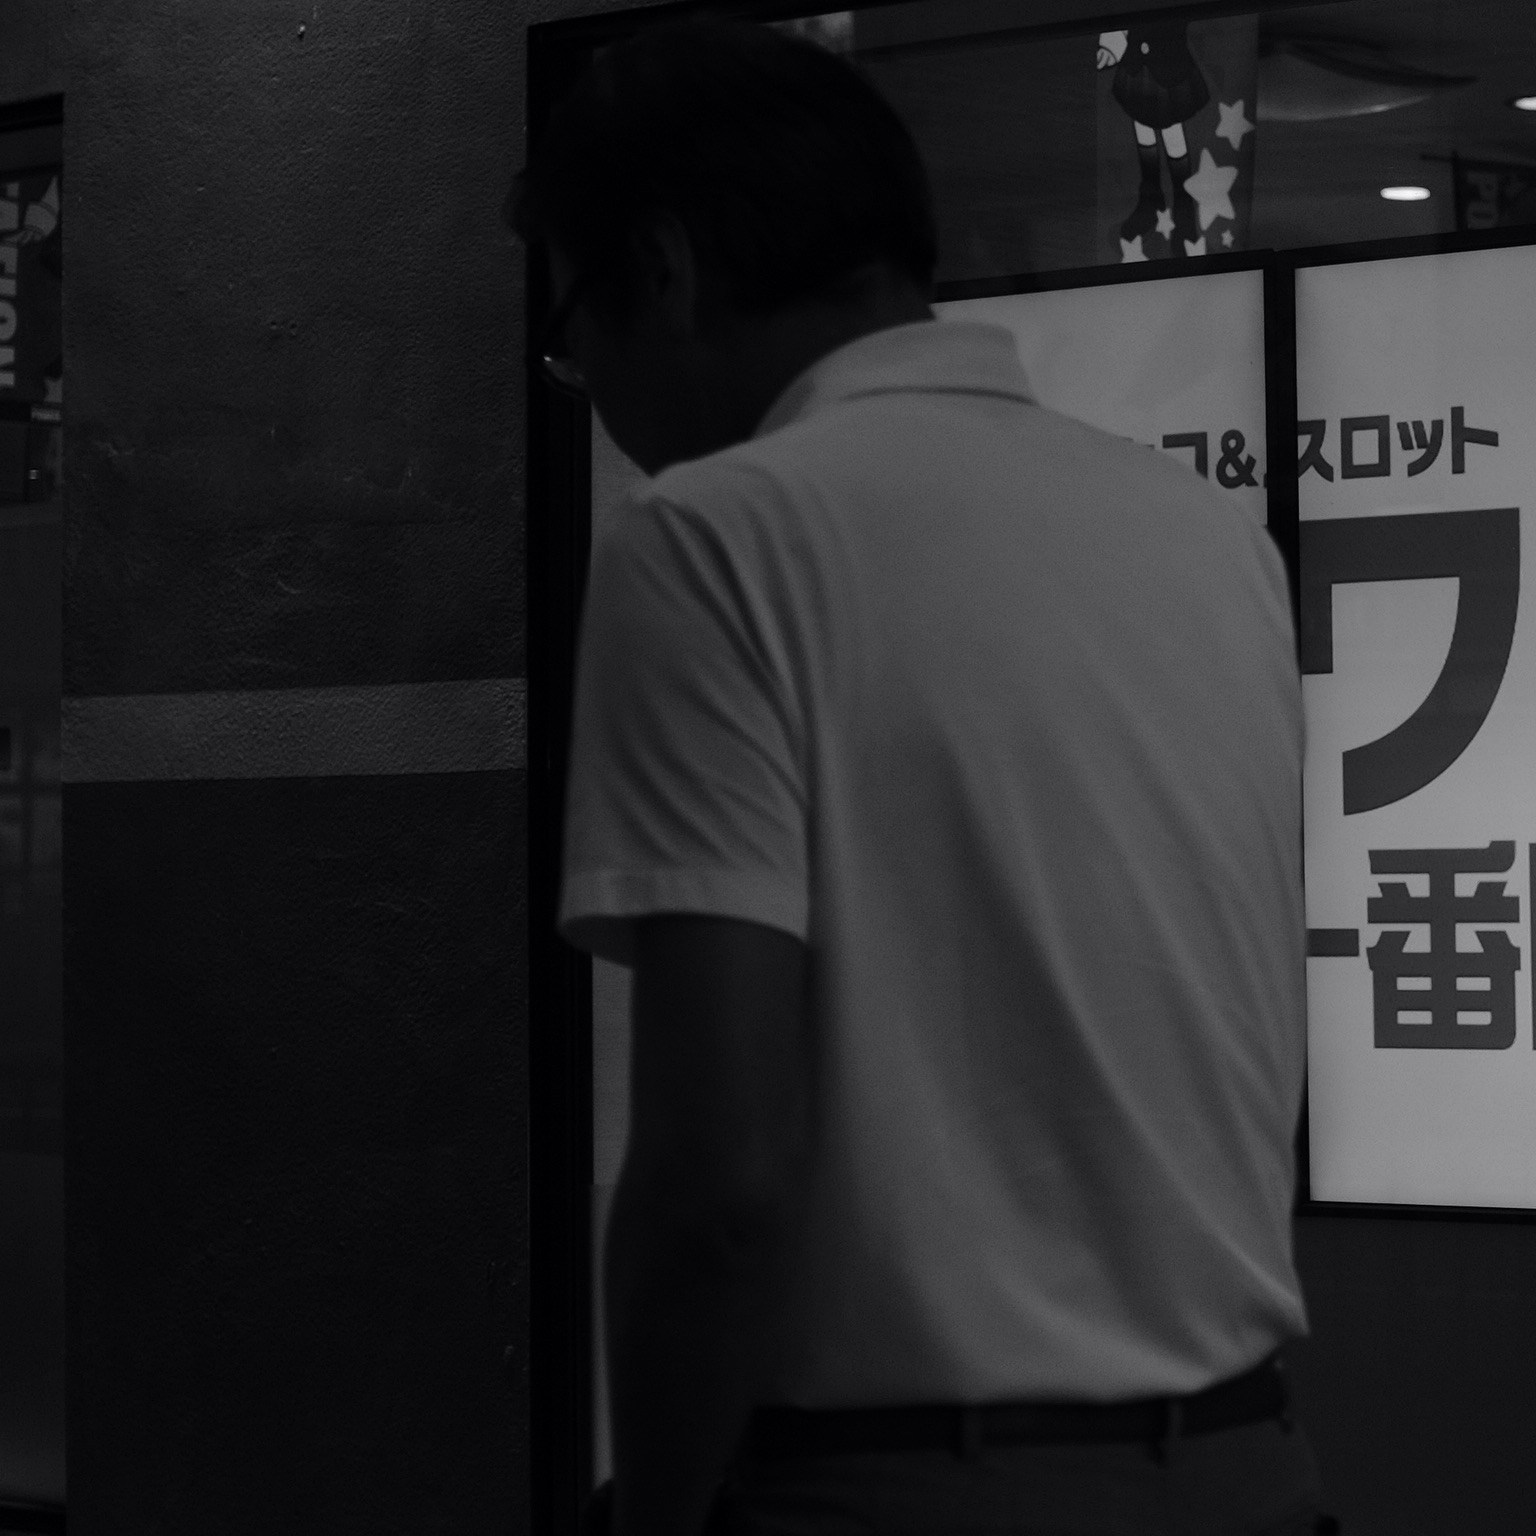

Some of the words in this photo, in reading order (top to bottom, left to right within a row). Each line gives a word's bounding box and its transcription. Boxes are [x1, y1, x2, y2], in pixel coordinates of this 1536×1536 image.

[1133, 406, 1499, 489] コ&スロット
